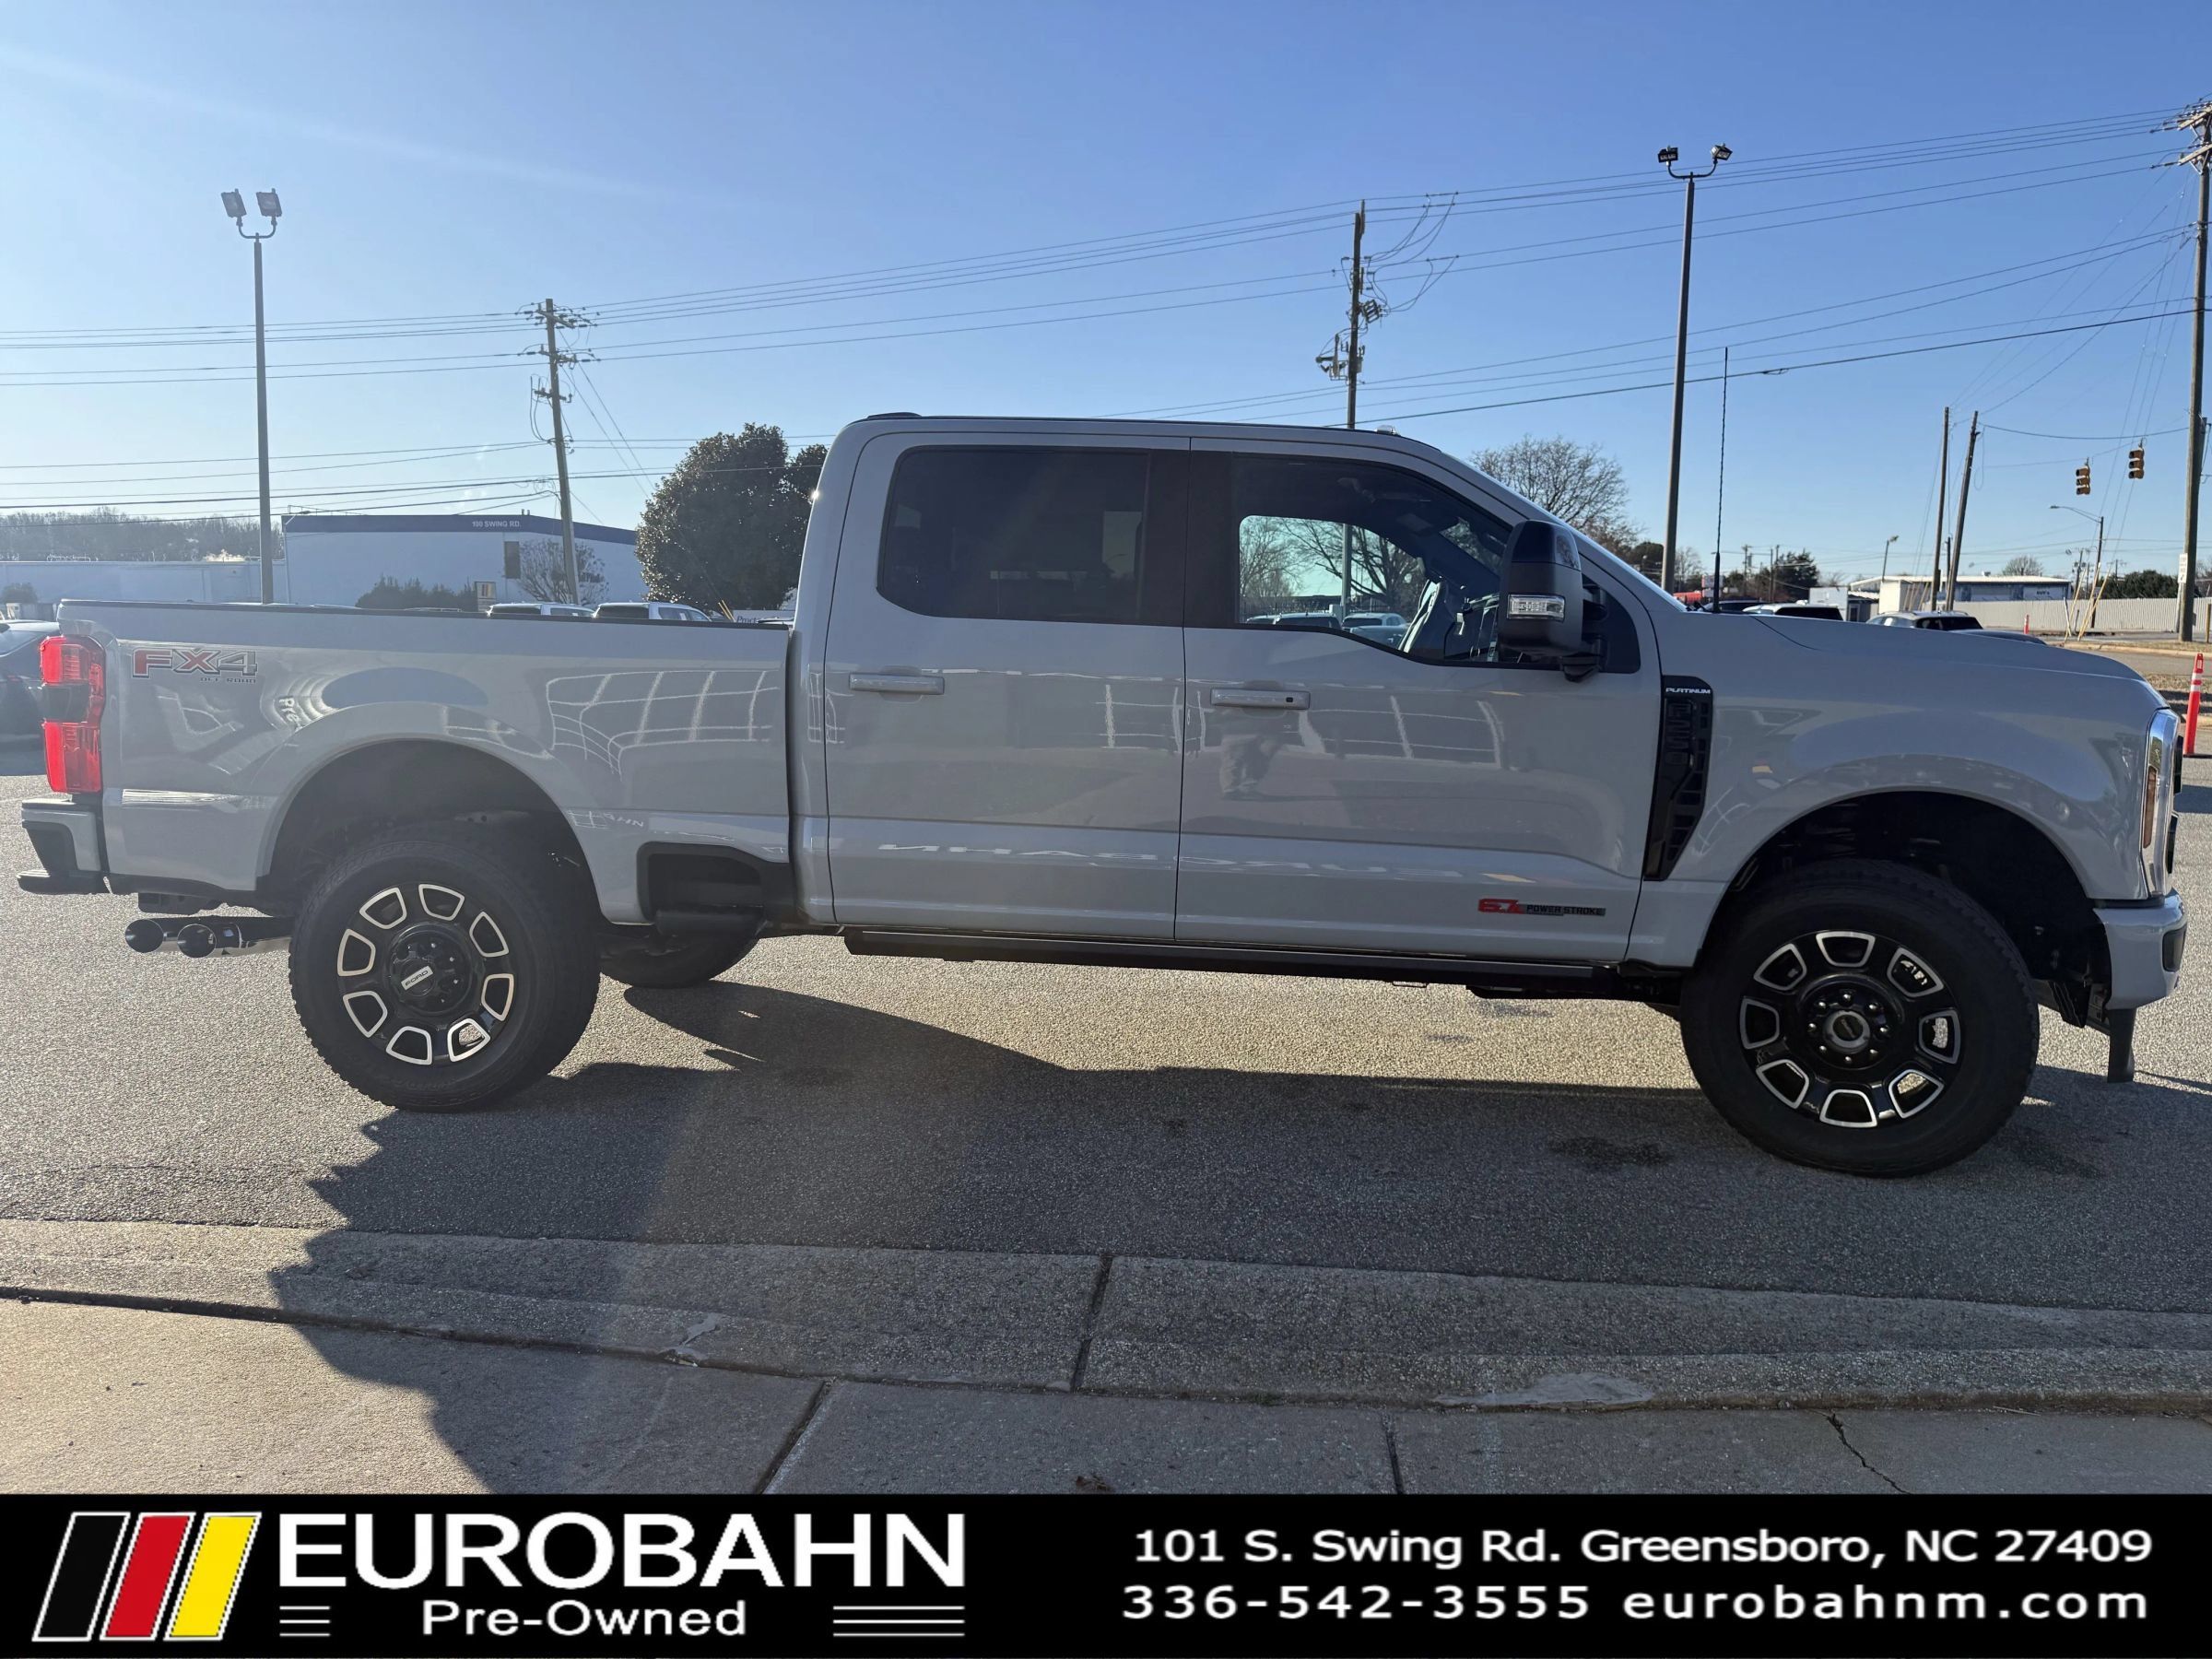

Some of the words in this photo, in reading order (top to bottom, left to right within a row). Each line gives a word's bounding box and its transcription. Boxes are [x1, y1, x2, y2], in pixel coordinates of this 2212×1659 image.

[484, 520, 508, 528] SWING
[132, 647, 258, 678] FX4
[1526, 904, 1562, 913] POWER
[1563, 906, 1606, 916] STROKE
[406, 970, 429, 986] FORD
